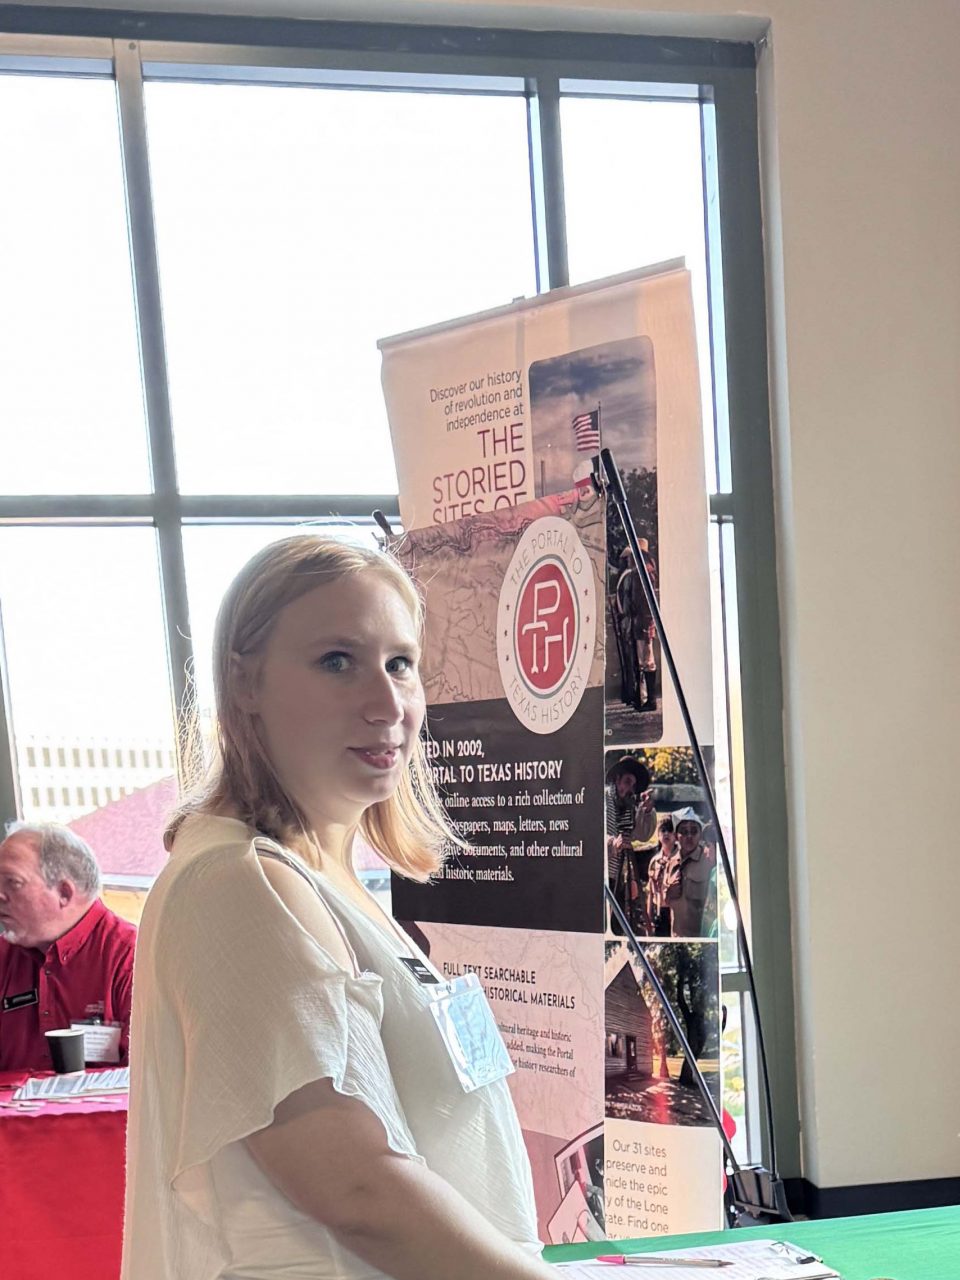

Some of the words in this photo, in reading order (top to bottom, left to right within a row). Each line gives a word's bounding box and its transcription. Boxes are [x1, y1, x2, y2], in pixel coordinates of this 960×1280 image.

[430, 383, 467, 403] Discover
[470, 378, 485, 392] our
[487, 369, 522, 387] history
[444, 403, 455, 416] of
[455, 391, 501, 413] revolution
[504, 384, 523, 401] and
[446, 407, 511, 432] independence
[513, 403, 524, 416] at
[477, 422, 525, 458] THE
[433, 460, 526, 504] STORIED
[510, 547, 530, 586] THE
[531, 530, 569, 556] PORTAL
[570, 547, 583, 575] TO
[509, 674, 537, 721] TEXAS
[541, 667, 582, 725] HISTORY
[442, 740, 454, 757] IN
[457, 739, 485, 758] 2002,
[459, 765, 474, 783] TO
[477, 763, 511, 781] TEXAS
[515, 760, 563, 780] HISTORY
[445, 792, 469, 808] online
[471, 797, 495, 807] access
[497, 794, 506, 807] to
[508, 796, 513, 807] a
[515, 790, 531, 806] rich
[533, 788, 573, 806] collection
[575, 786, 585, 804] of
[493, 820, 517, 835] maps,
[519, 815, 547, 833] letters,
[549, 819, 569, 831] news
[510, 840, 524, 857] and
[527, 840, 549, 857] other
[551, 840, 583, 857] cultural
[445, 863, 474, 880] historic
[475, 865, 514, 881] materials.
[443, 962, 461, 976] FULL
[463, 964, 482, 976] TEXT
[484, 966, 536, 984] SEARCHABLE
[483, 986, 528, 1004] HISTORICAL
[530, 992, 576, 1009] MATERIALS
[517, 1024, 539, 1040] heritage
[540, 1028, 551, 1038] and
[548, 1046, 556, 1056] the
[556, 1047, 574, 1059] Portal
[518, 1057, 538, 1073] history
[569, 1066, 577, 1077] of
[613, 1139, 630, 1152] Our
[633, 1143, 642, 1155] 31
[645, 1146, 667, 1158] sites
[606, 1159, 646, 1174] preserve
[648, 1165, 667, 1177] and
[605, 1176, 627, 1190] nicle
[630, 1179, 645, 1192] the
[647, 1184, 668, 1196] epic
[615, 1195, 625, 1207] of
[626, 1197, 642, 1210] the
[644, 1200, 669, 1215] Lone
[627, 1215, 649, 1230] Find
[650, 1221, 669, 1233] one
